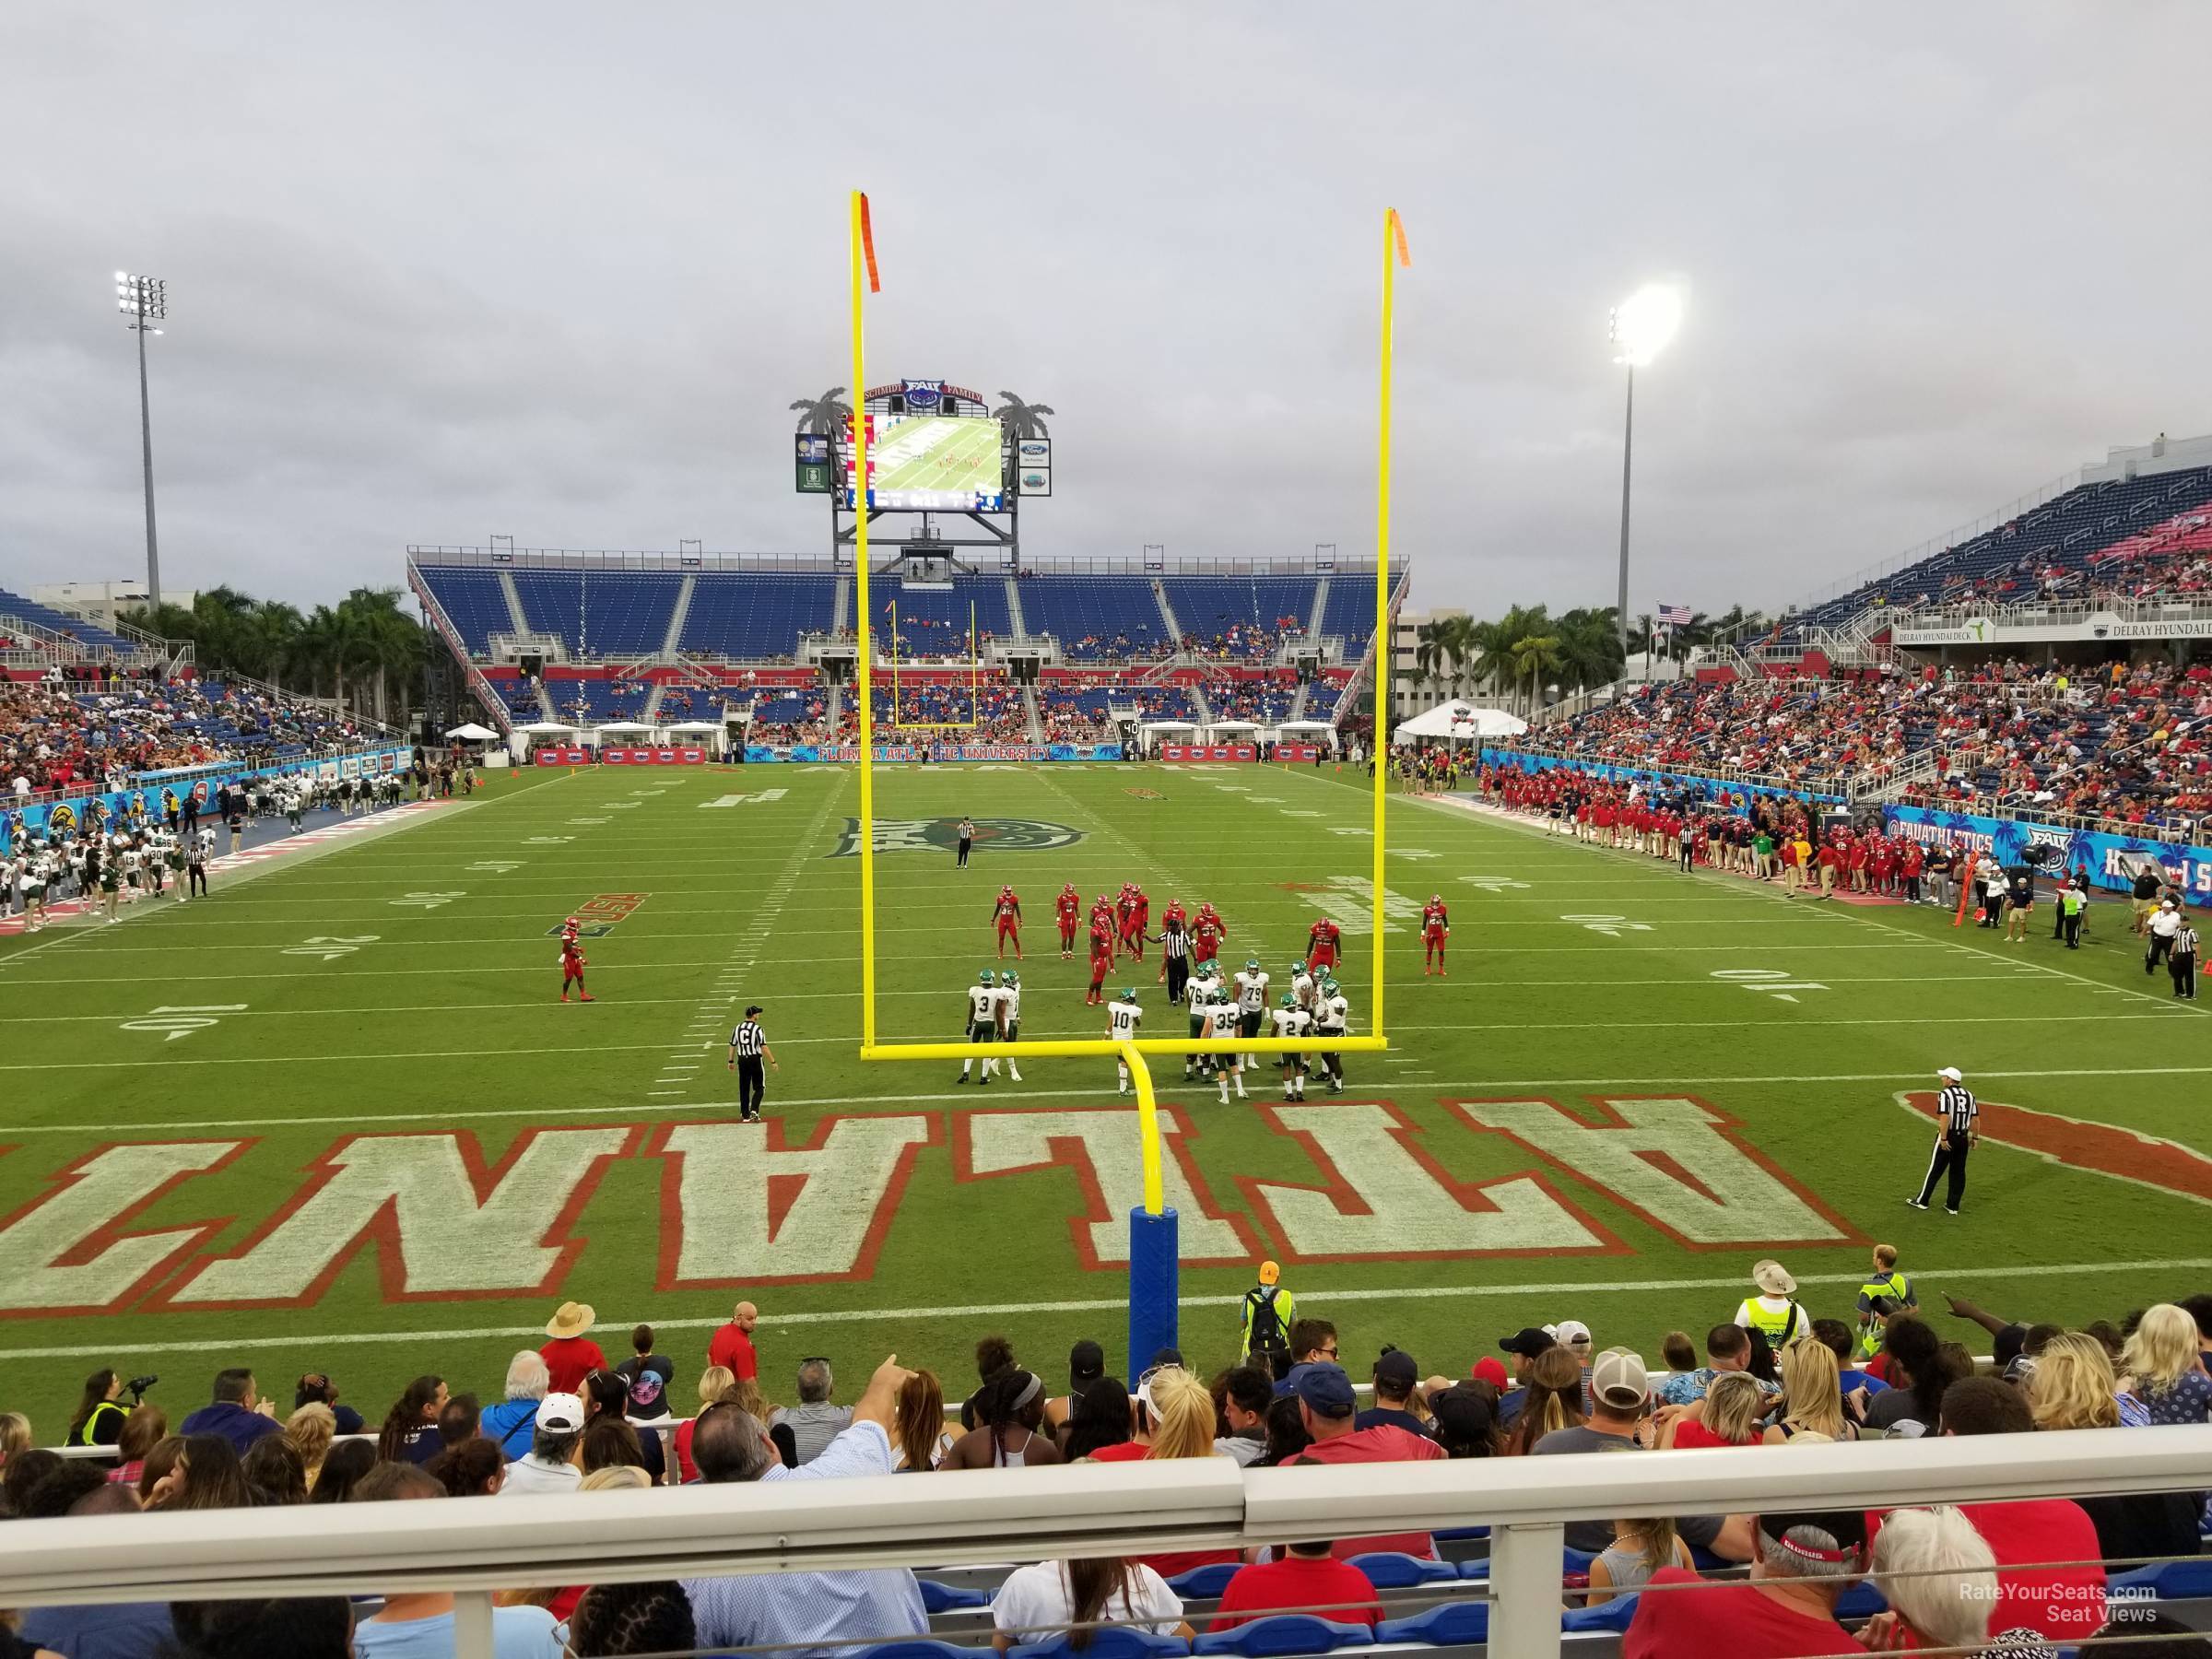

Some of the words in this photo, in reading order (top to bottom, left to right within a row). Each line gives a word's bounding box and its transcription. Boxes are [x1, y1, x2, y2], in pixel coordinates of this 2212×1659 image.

[865, 384, 902, 400] SCHMIDT
[906, 381, 940, 393] FAU
[947, 385, 982, 402] FAMILY
[1899, 632, 1921, 641] DELRAY
[1922, 632, 1953, 641] HYUNDAI
[1954, 631, 1971, 641] DECK
[2113, 625, 2152, 637] DELRAY
[2154, 623, 2205, 635] HYUNDAI
[1124, 724, 1138, 735] 40
[819, 747, 880, 760] FLORIA
[962, 747, 1051, 760] UNIVERSITY
[2031, 830, 2067, 850] FAU
[151, 850, 162, 860] 30
[37, 869, 48, 880] 87
[1708, 969, 1833, 992] 10
[1189, 985, 1203, 1004] 76
[1248, 987, 1262, 1002] 79
[979, 995, 990, 1013] 3
[118, 1003, 250, 1031] 10
[1113, 1010, 1129, 1030] 10
[1216, 1012, 1236, 1030] 35
[1286, 1020, 1296, 1037] 2
[739, 1029, 751, 1045] C
[1956, 1095, 1968, 1113] R
